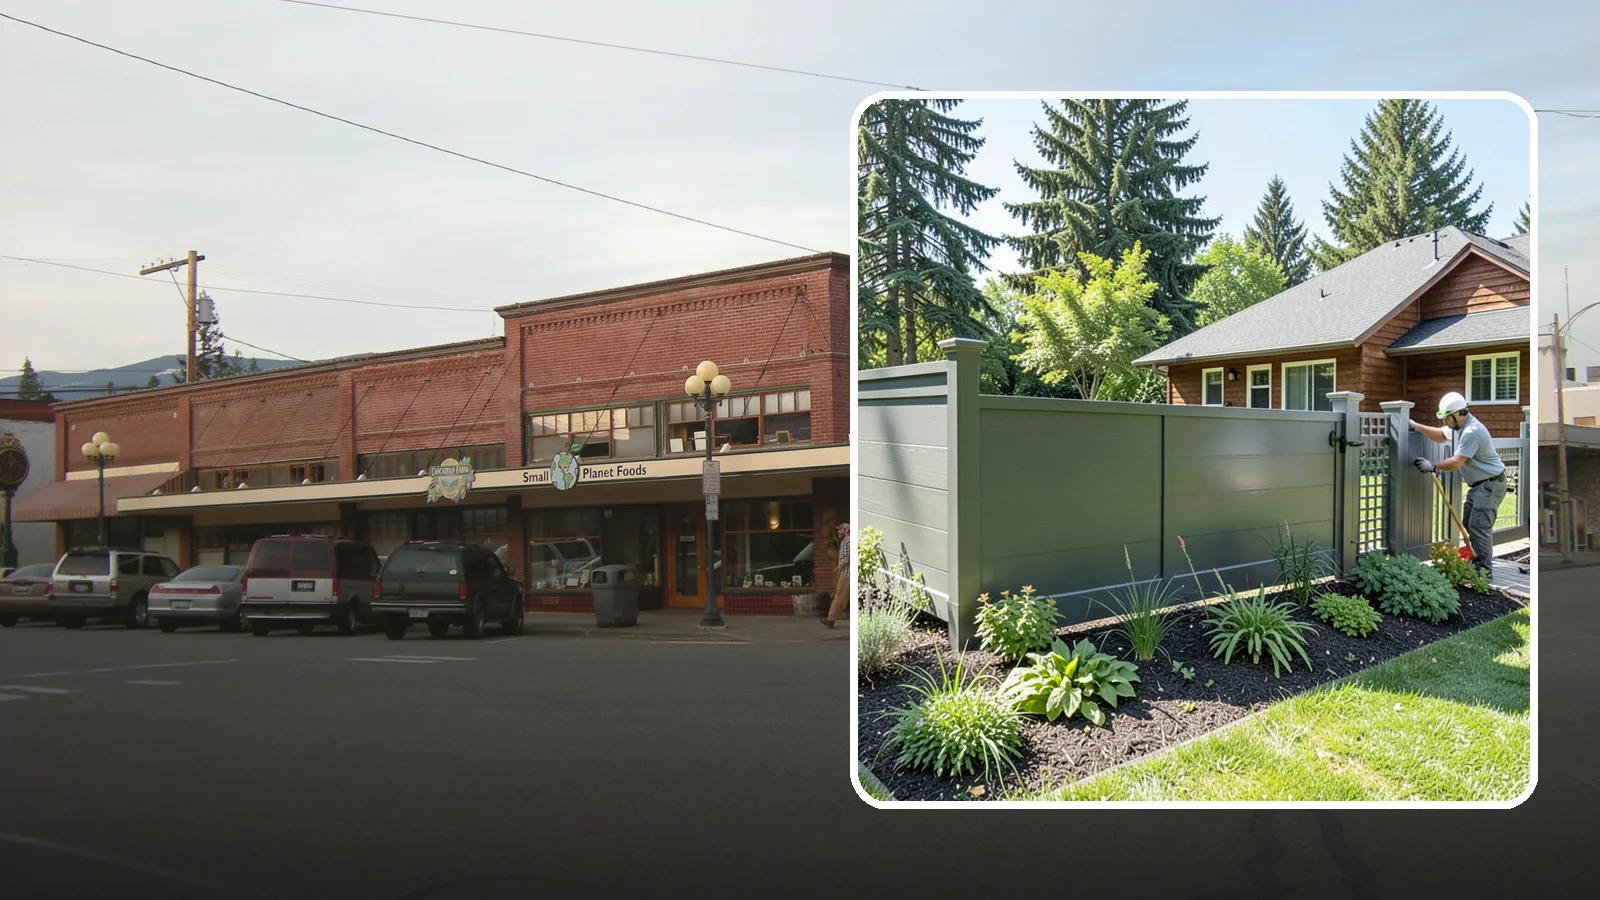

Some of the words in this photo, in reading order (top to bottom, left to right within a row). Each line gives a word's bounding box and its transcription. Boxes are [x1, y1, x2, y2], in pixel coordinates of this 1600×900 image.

[522, 471, 549, 484] Small
[582, 467, 614, 479] Planet
[616, 464, 647, 477] Foods
